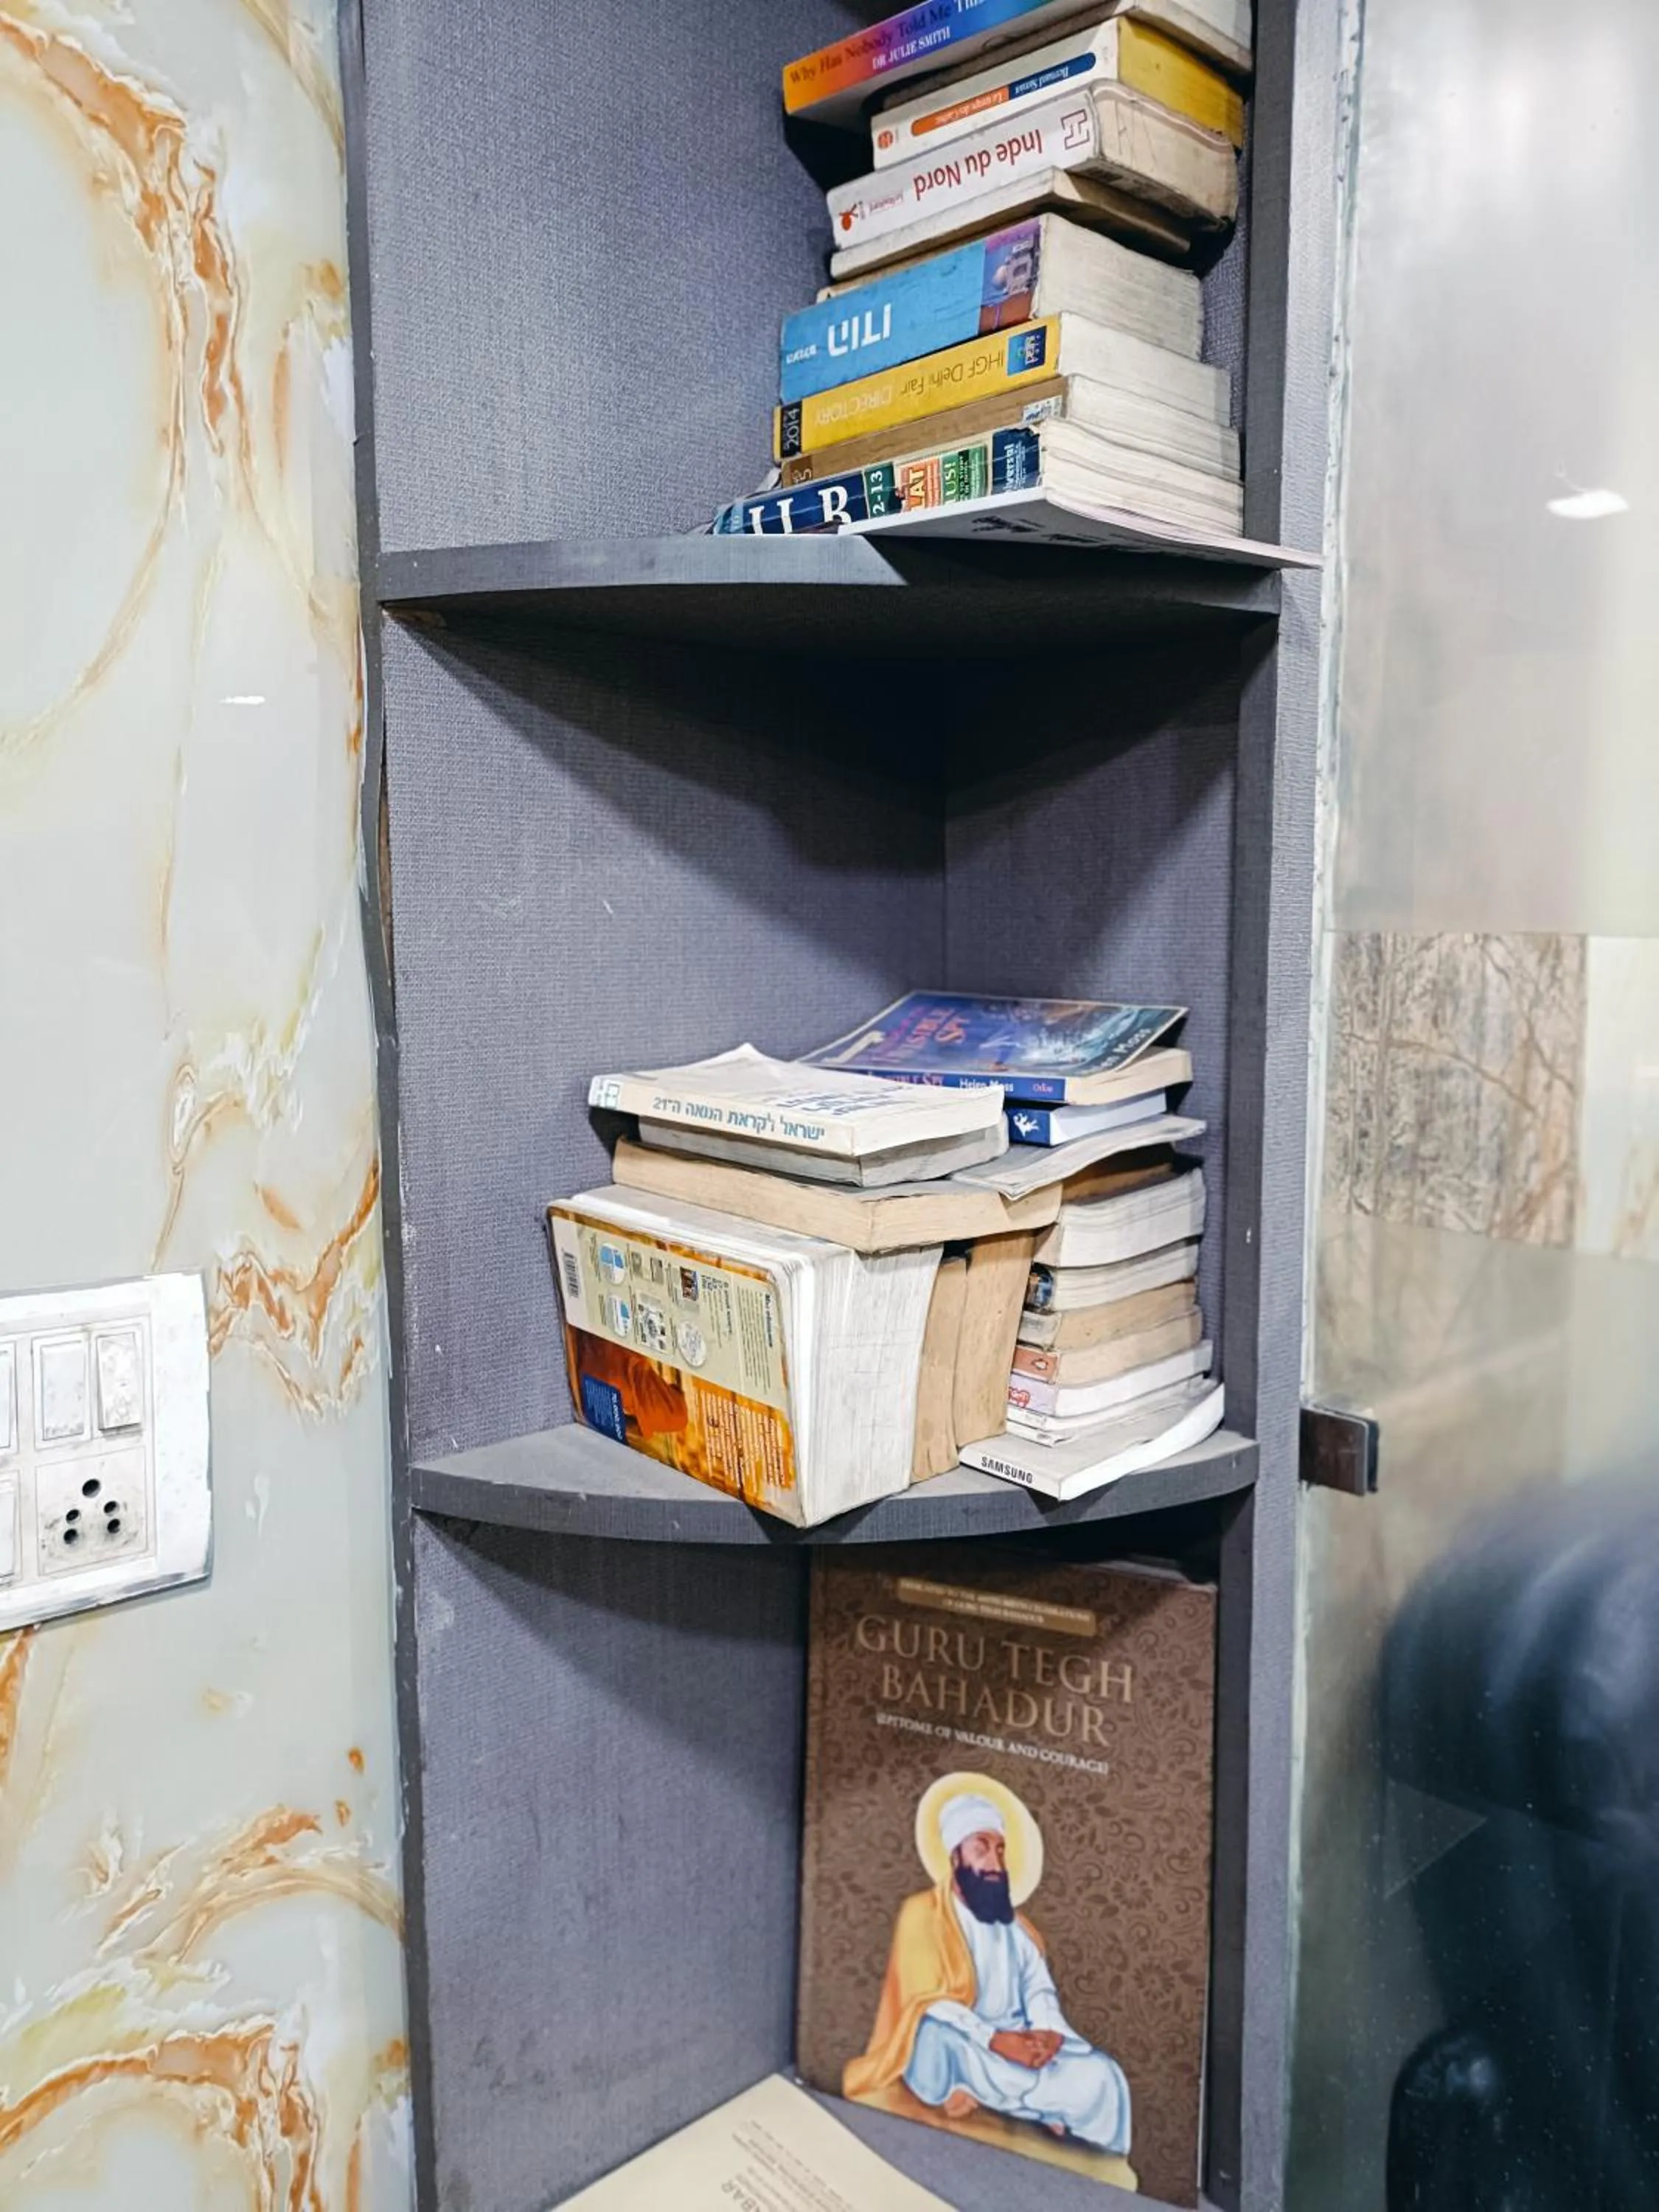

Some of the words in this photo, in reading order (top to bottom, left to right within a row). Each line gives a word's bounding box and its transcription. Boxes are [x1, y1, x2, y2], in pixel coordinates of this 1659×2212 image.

[790, 65, 816, 84] Why
[819, 51, 843, 72] Has
[844, 31, 893, 60] Nobody
[897, 15, 927, 38] Told
[929, 3, 953, 24] Me
[917, 27, 951, 51] SMITH
[964, 147, 990, 179] du
[996, 129, 1042, 164] Inde
[914, 159, 961, 201] Nord
[927, 361, 964, 386] Delhi
[970, 351, 1004, 378] IHGF
[900, 375, 925, 397] Fair
[814, 385, 894, 425] DIRECTORY
[785, 406, 801, 450] 2014
[728, 1110, 774, 1134] לקראת
[780, 1115, 825, 1141] ישראל
[981, 1456, 1033, 1484] SAMSUNG
[856, 1615, 985, 1672] GURU
[1001, 1639, 1133, 1703] TEGH
[882, 1664, 1110, 1747] BAHADUR
[876, 1714, 933, 1735] EPITOME
[935, 1725, 950, 1739] OF
[955, 1729, 1005, 1753] VALOUR
[1007, 1742, 1038, 1760] AND
[1039, 1747, 1110, 1774] COURAGE
